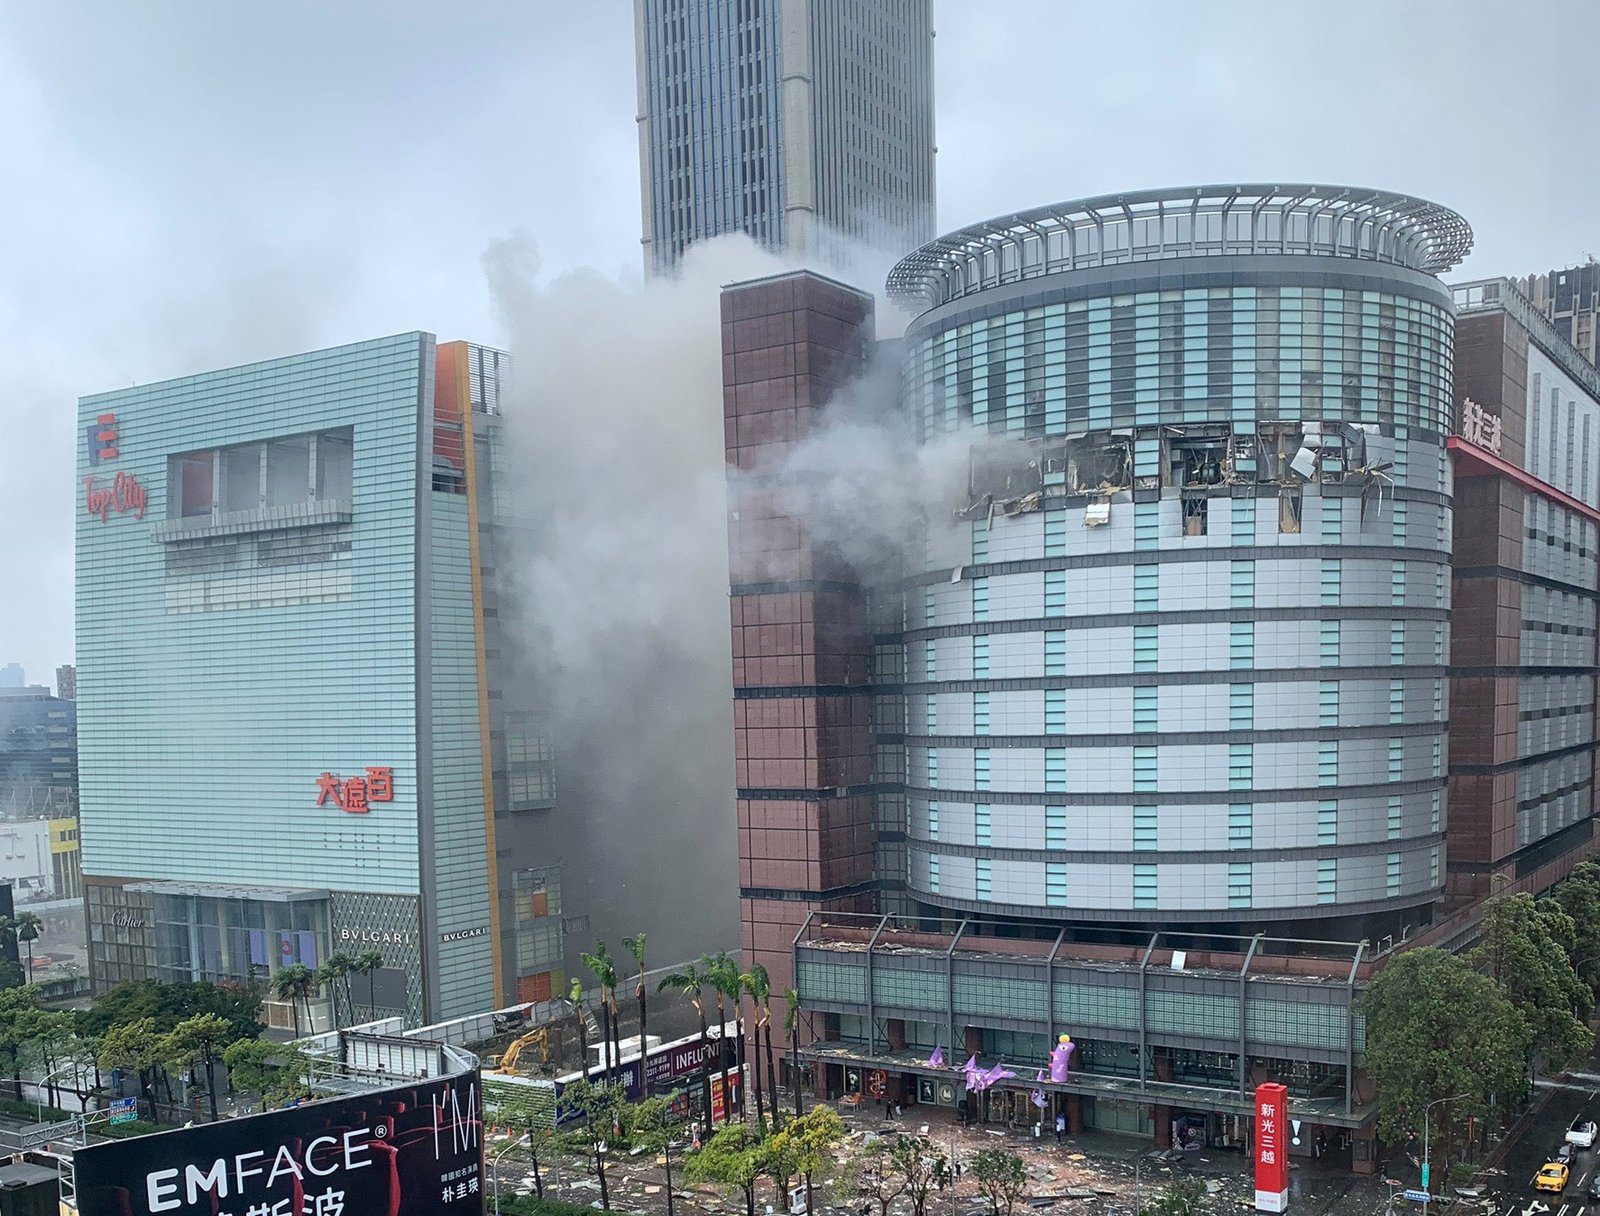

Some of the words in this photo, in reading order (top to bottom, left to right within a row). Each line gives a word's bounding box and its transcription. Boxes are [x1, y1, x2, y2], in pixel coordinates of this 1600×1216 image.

[112, 909, 144, 928] Cartier
[342, 929, 409, 944] BVLGARI
[443, 927, 486, 942] BVLGARI
[676, 1042, 720, 1070] INFLUNT
[1261, 1103, 1275, 1164] 新光三越
